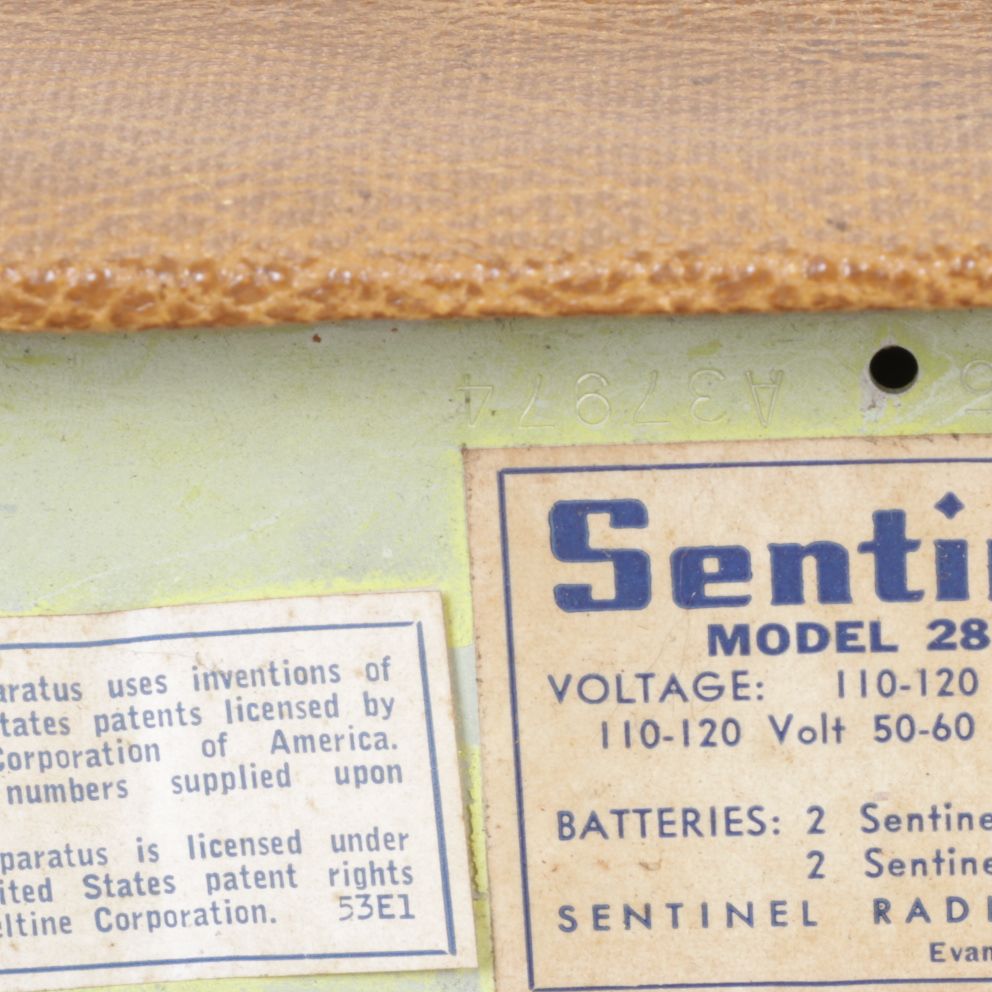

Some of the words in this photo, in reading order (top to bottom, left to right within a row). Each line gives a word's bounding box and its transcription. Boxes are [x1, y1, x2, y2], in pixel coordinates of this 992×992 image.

[707, 619, 900, 658] MODEL
[107, 674, 168, 699] uses
[191, 659, 341, 692] inventions
[365, 655, 391, 683] of
[546, 669, 764, 705] VOLTAGE:
[837, 666, 980, 699] 110-120
[93, 701, 203, 738] patents
[224, 692, 340, 725] licensed
[362, 690, 395, 721] by
[601, 716, 742, 750] 110-120
[767, 711, 847, 746] Volt
[873, 711, 976, 744] 50-60
[201, 731, 228, 758] of
[270, 724, 398, 755] America.
[6, 776, 129, 806] numbers
[170, 761, 292, 797] supplied
[334, 763, 403, 789] upon
[556, 804, 781, 842] BATTERIES:
[806, 804, 826, 835] 2
[135, 836, 160, 864] is
[187, 828, 303, 861] licensed
[330, 826, 409, 854] under
[806, 849, 826, 880] 2
[82, 871, 177, 900] States
[205, 863, 298, 896] patent
[328, 859, 414, 891] rights
[0, 912, 72, 938] ltine
[94, 898, 277, 934] Corporation.
[338, 893, 416, 922] 53E1
[557, 899, 818, 934] SENTINEL
